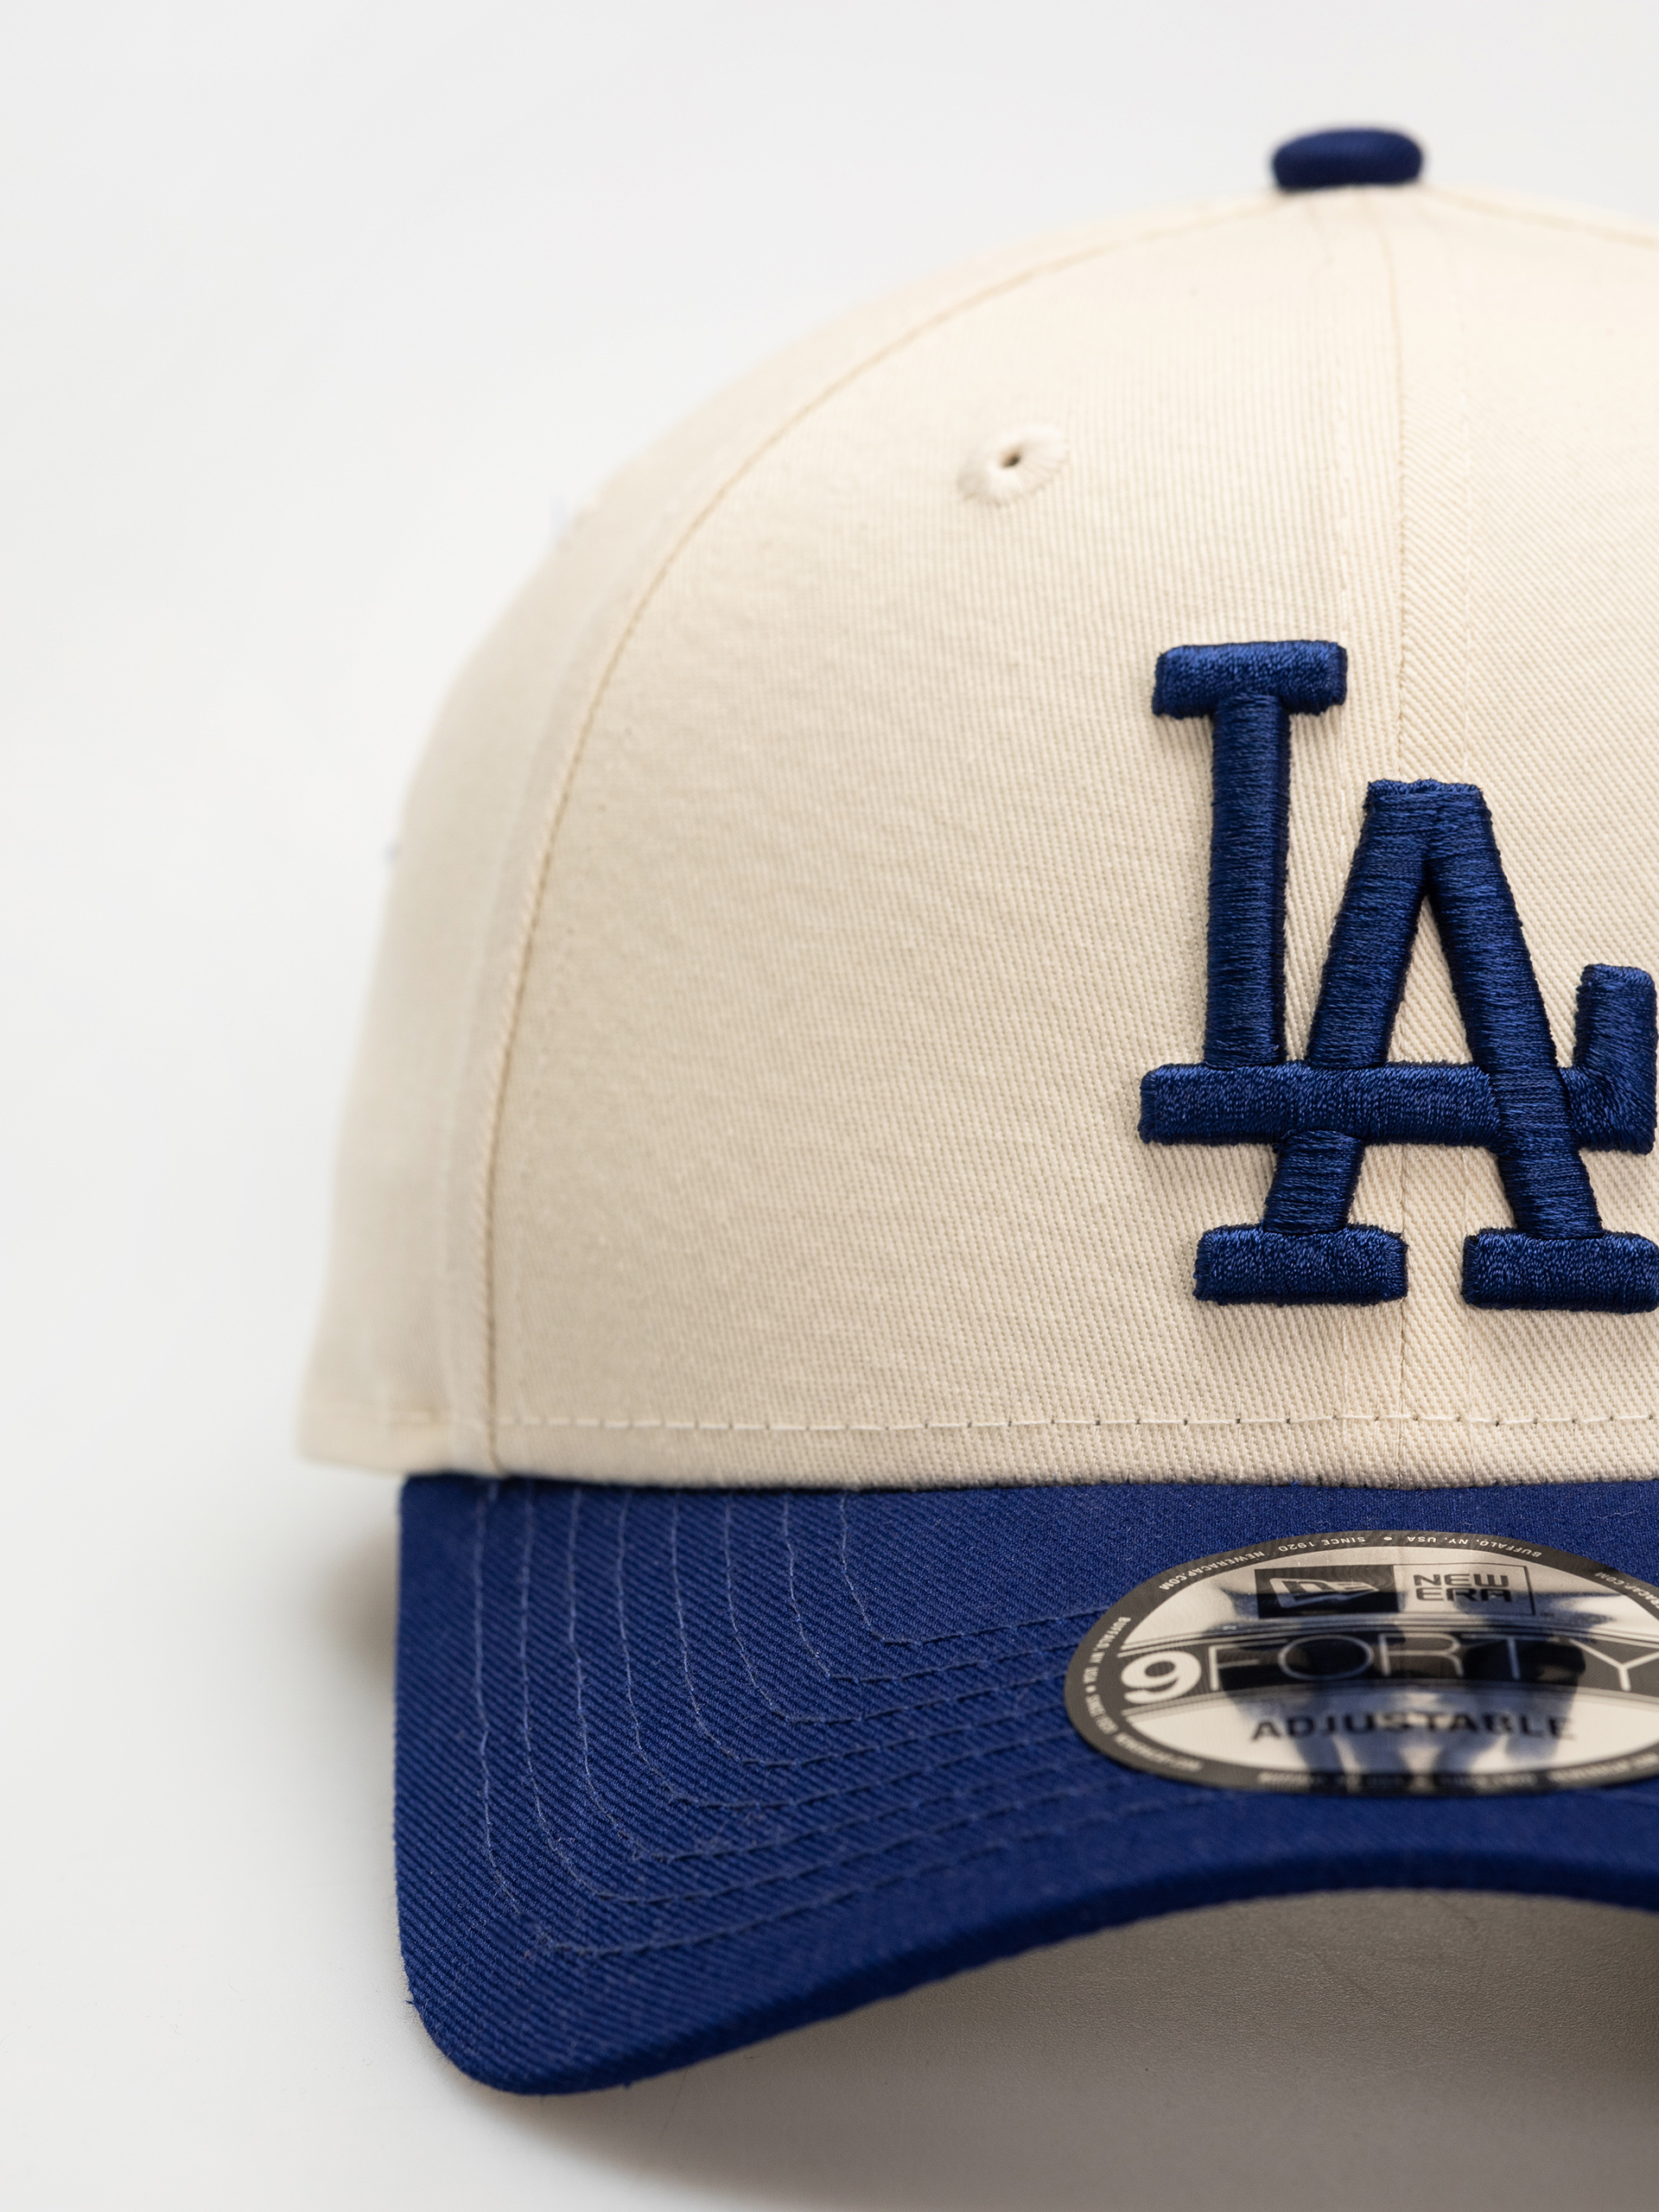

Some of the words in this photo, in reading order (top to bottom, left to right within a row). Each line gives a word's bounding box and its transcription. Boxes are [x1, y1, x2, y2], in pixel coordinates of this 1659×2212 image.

[1138, 640, 1659, 1313] LA
[1278, 1541, 1315, 1552] 1920
[1320, 1536, 1365, 1546] SINCE
[1159, 1551, 1265, 1591] NEWERACAP.COM
[1413, 1573, 1510, 1588] NEW
[1415, 1587, 1512, 1603] ERA
[1121, 1631, 1659, 1705] 9FORTY
[1250, 1710, 1576, 1742] ADJUSTABLE
